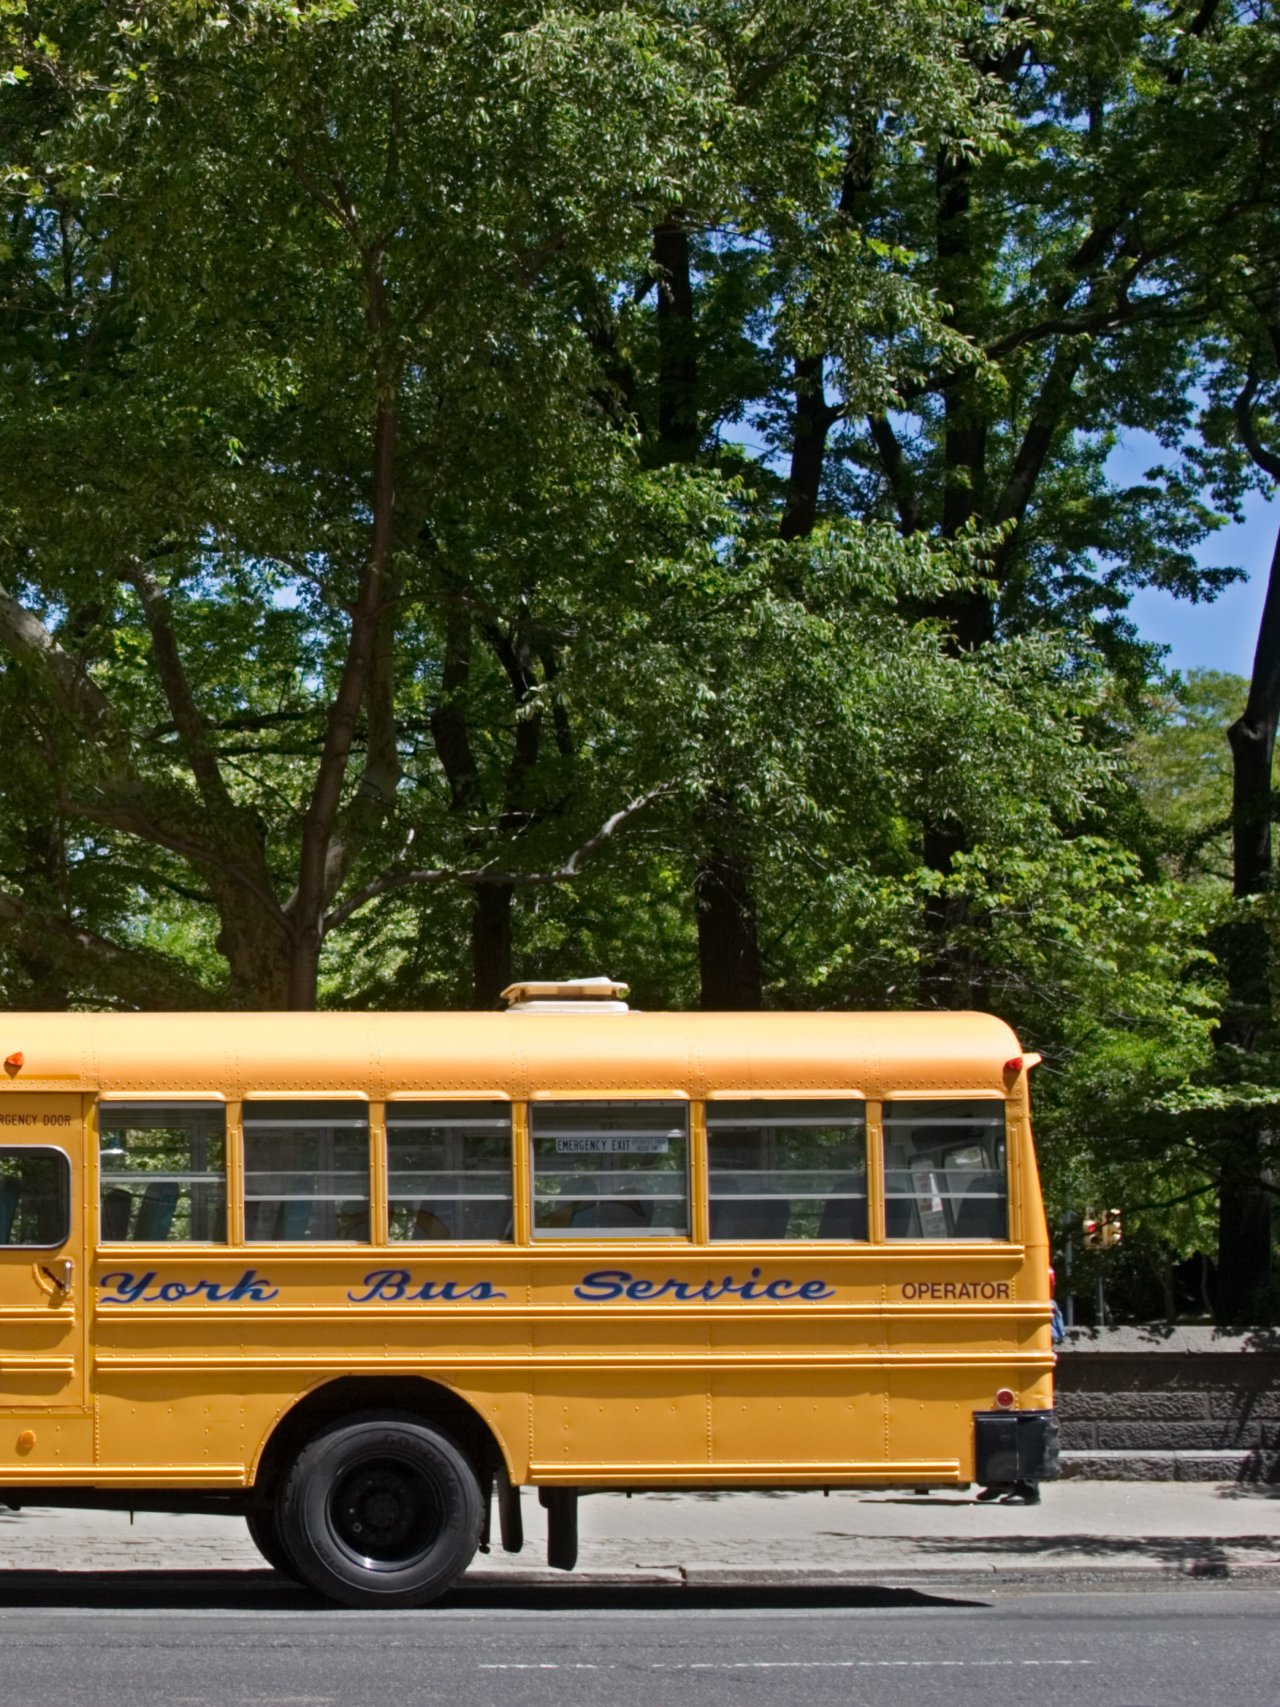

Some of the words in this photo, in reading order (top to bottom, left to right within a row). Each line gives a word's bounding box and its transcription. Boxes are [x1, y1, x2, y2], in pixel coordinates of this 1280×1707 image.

[43, 1114, 71, 1126] DOOR
[558, 1140, 607, 1151] EMERGENCY
[612, 1140, 630, 1151] EXIT
[99, 1269, 279, 1304] York
[347, 1269, 507, 1302] Bus
[574, 1267, 836, 1301] Service
[902, 1282, 1009, 1299] OPERATOR
[383, 1433, 463, 1529] GOODYEAR
